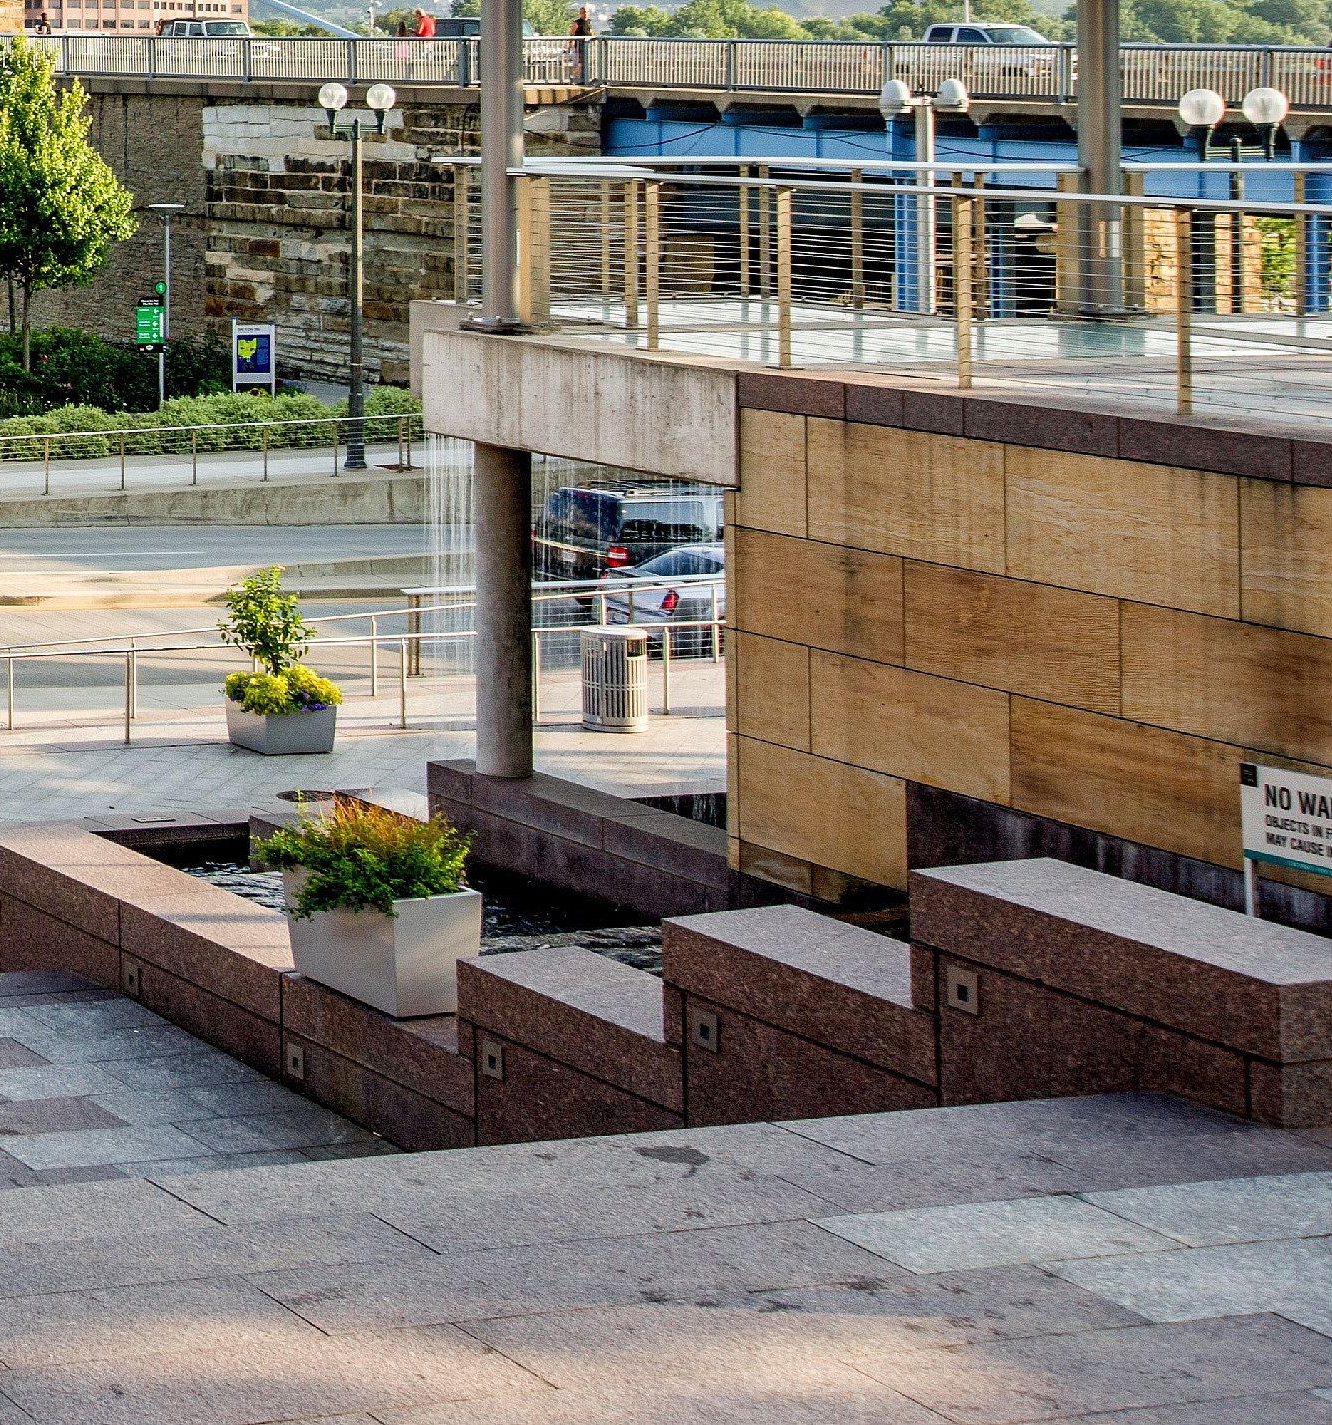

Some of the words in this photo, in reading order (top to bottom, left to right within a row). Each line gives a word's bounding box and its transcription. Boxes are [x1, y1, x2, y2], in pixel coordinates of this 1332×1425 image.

[1264, 783, 1292, 811] NO
[1297, 790, 1332, 820] WA
[1264, 813, 1310, 836] OBJECTS
[1266, 831, 1287, 847] MAY
[1290, 837, 1325, 857] CAUSE
